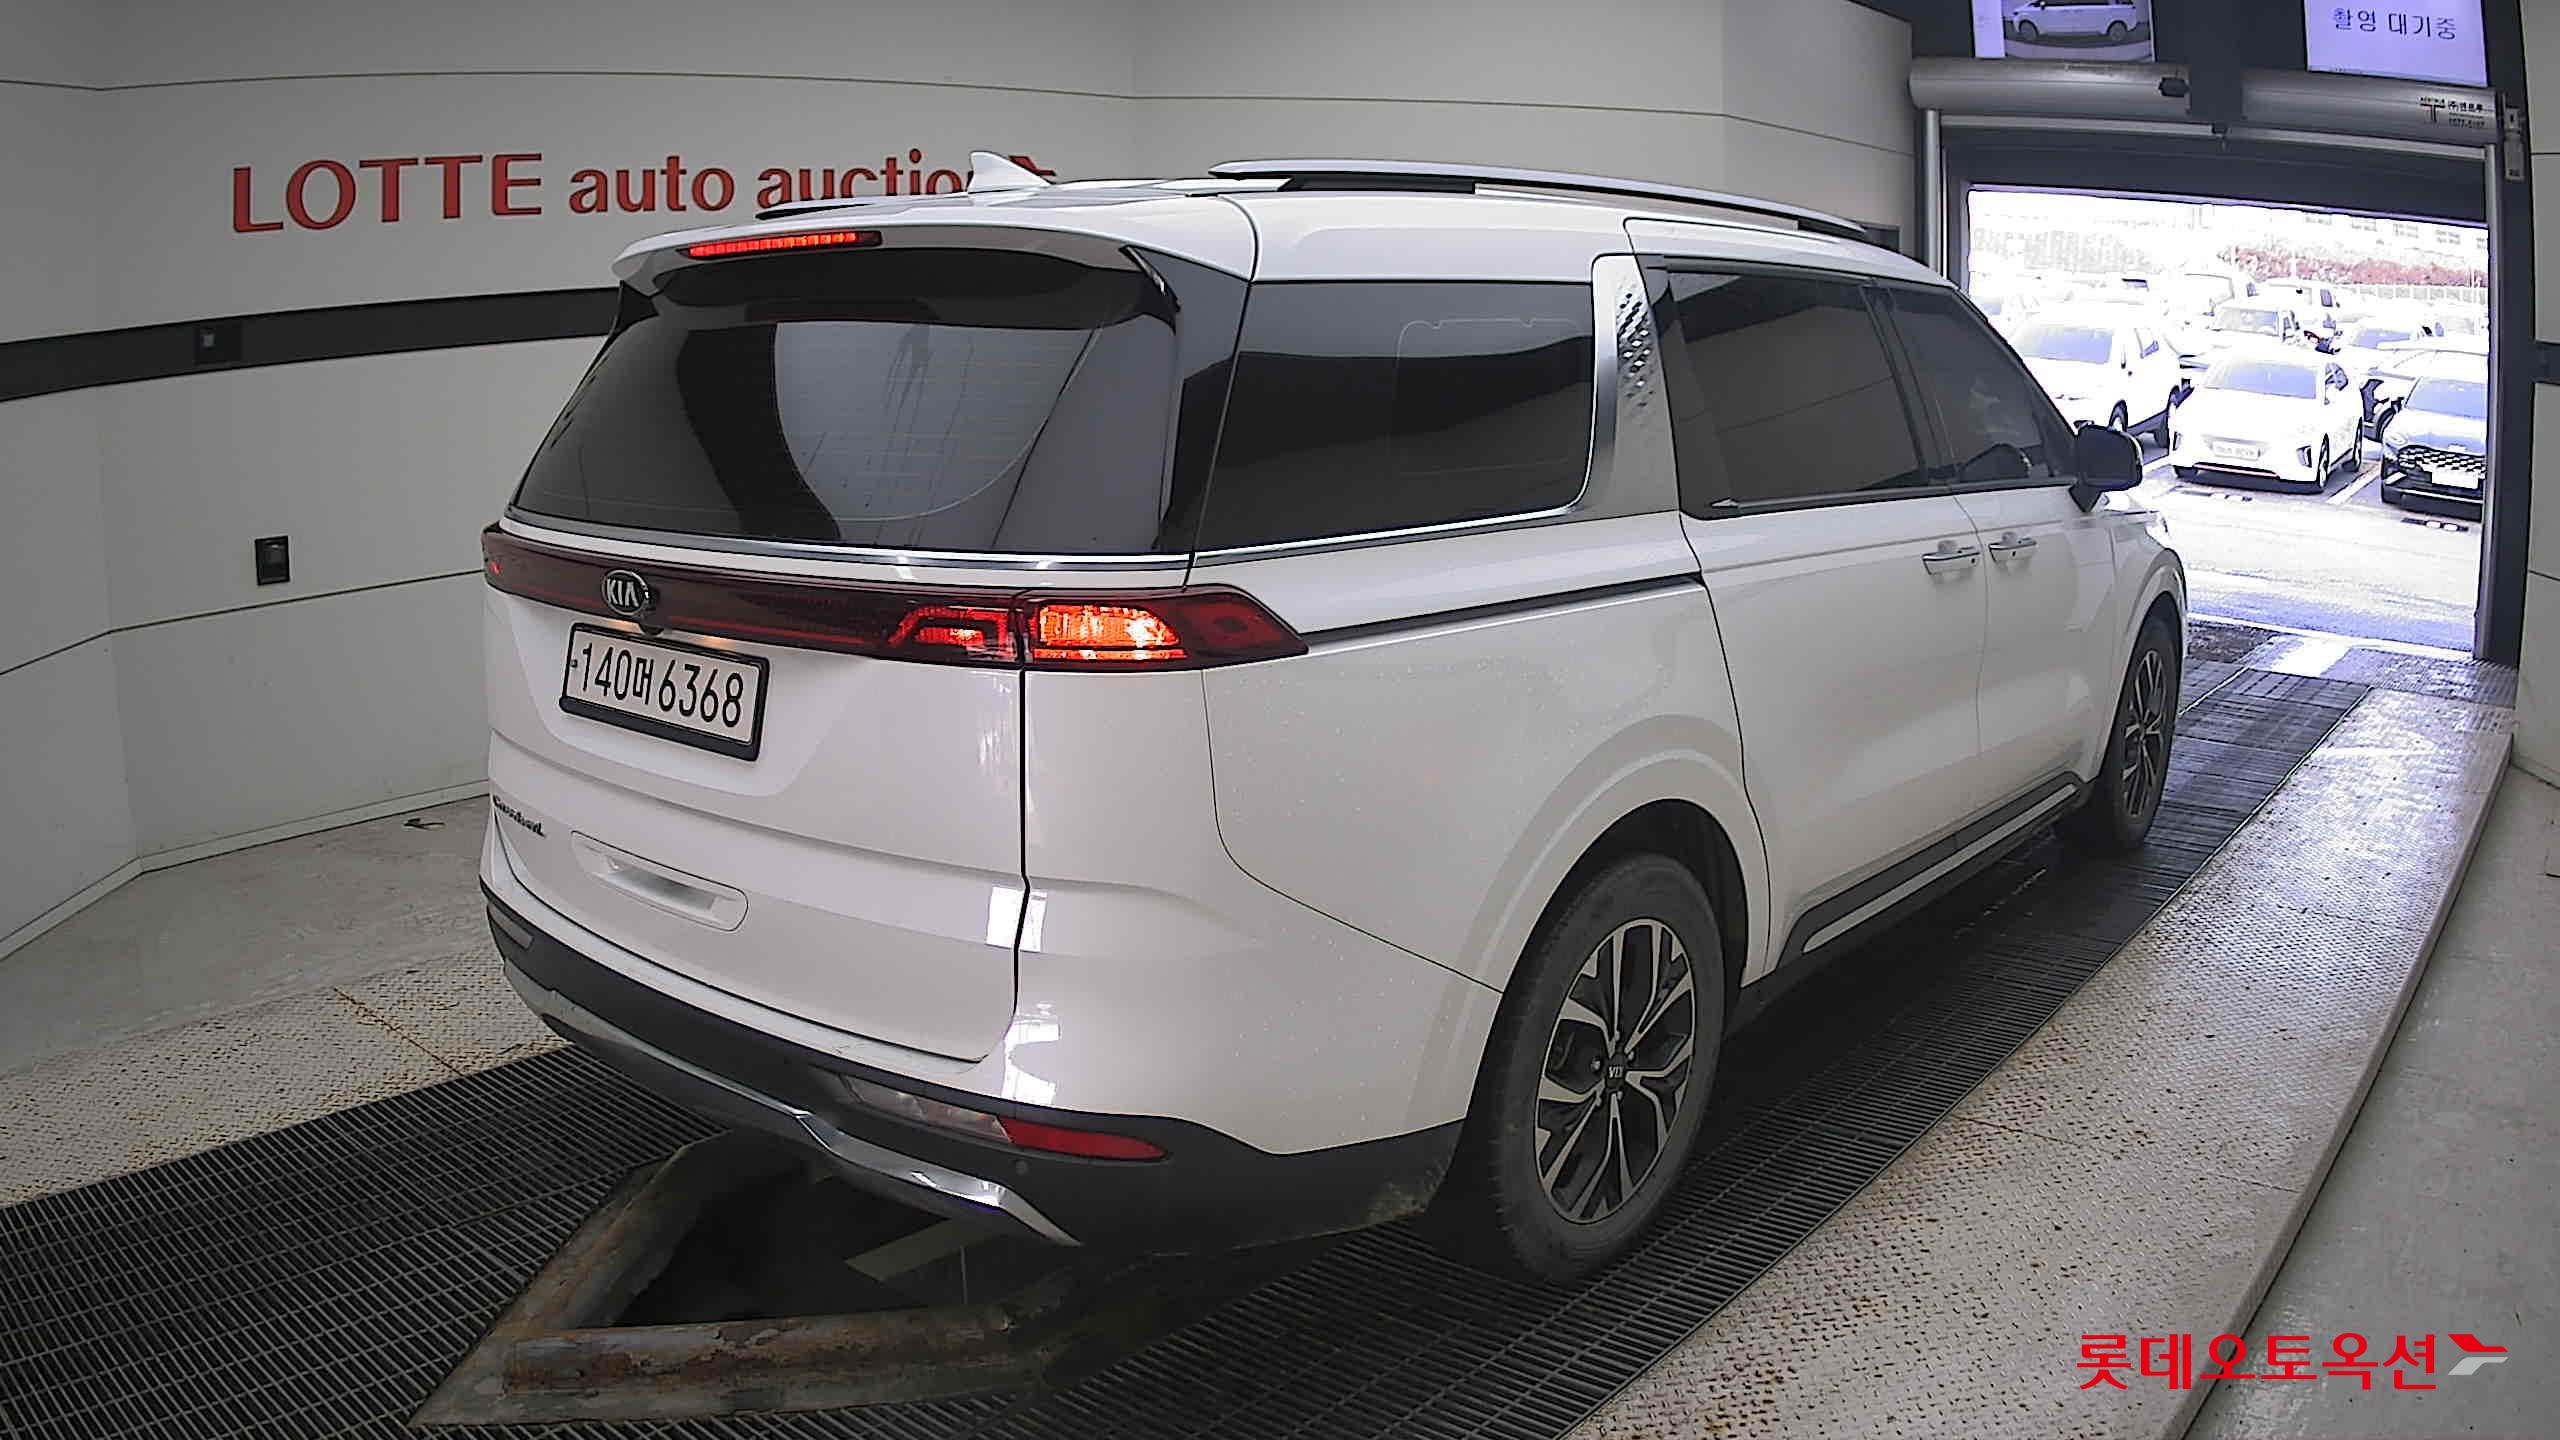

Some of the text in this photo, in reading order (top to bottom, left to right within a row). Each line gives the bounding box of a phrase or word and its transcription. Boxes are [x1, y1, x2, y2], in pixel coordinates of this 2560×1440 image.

[2387, 12, 2457, 41] 대기중
[232, 149, 973, 233] LOTTE auto auctio
[605, 578, 642, 607] KIA
